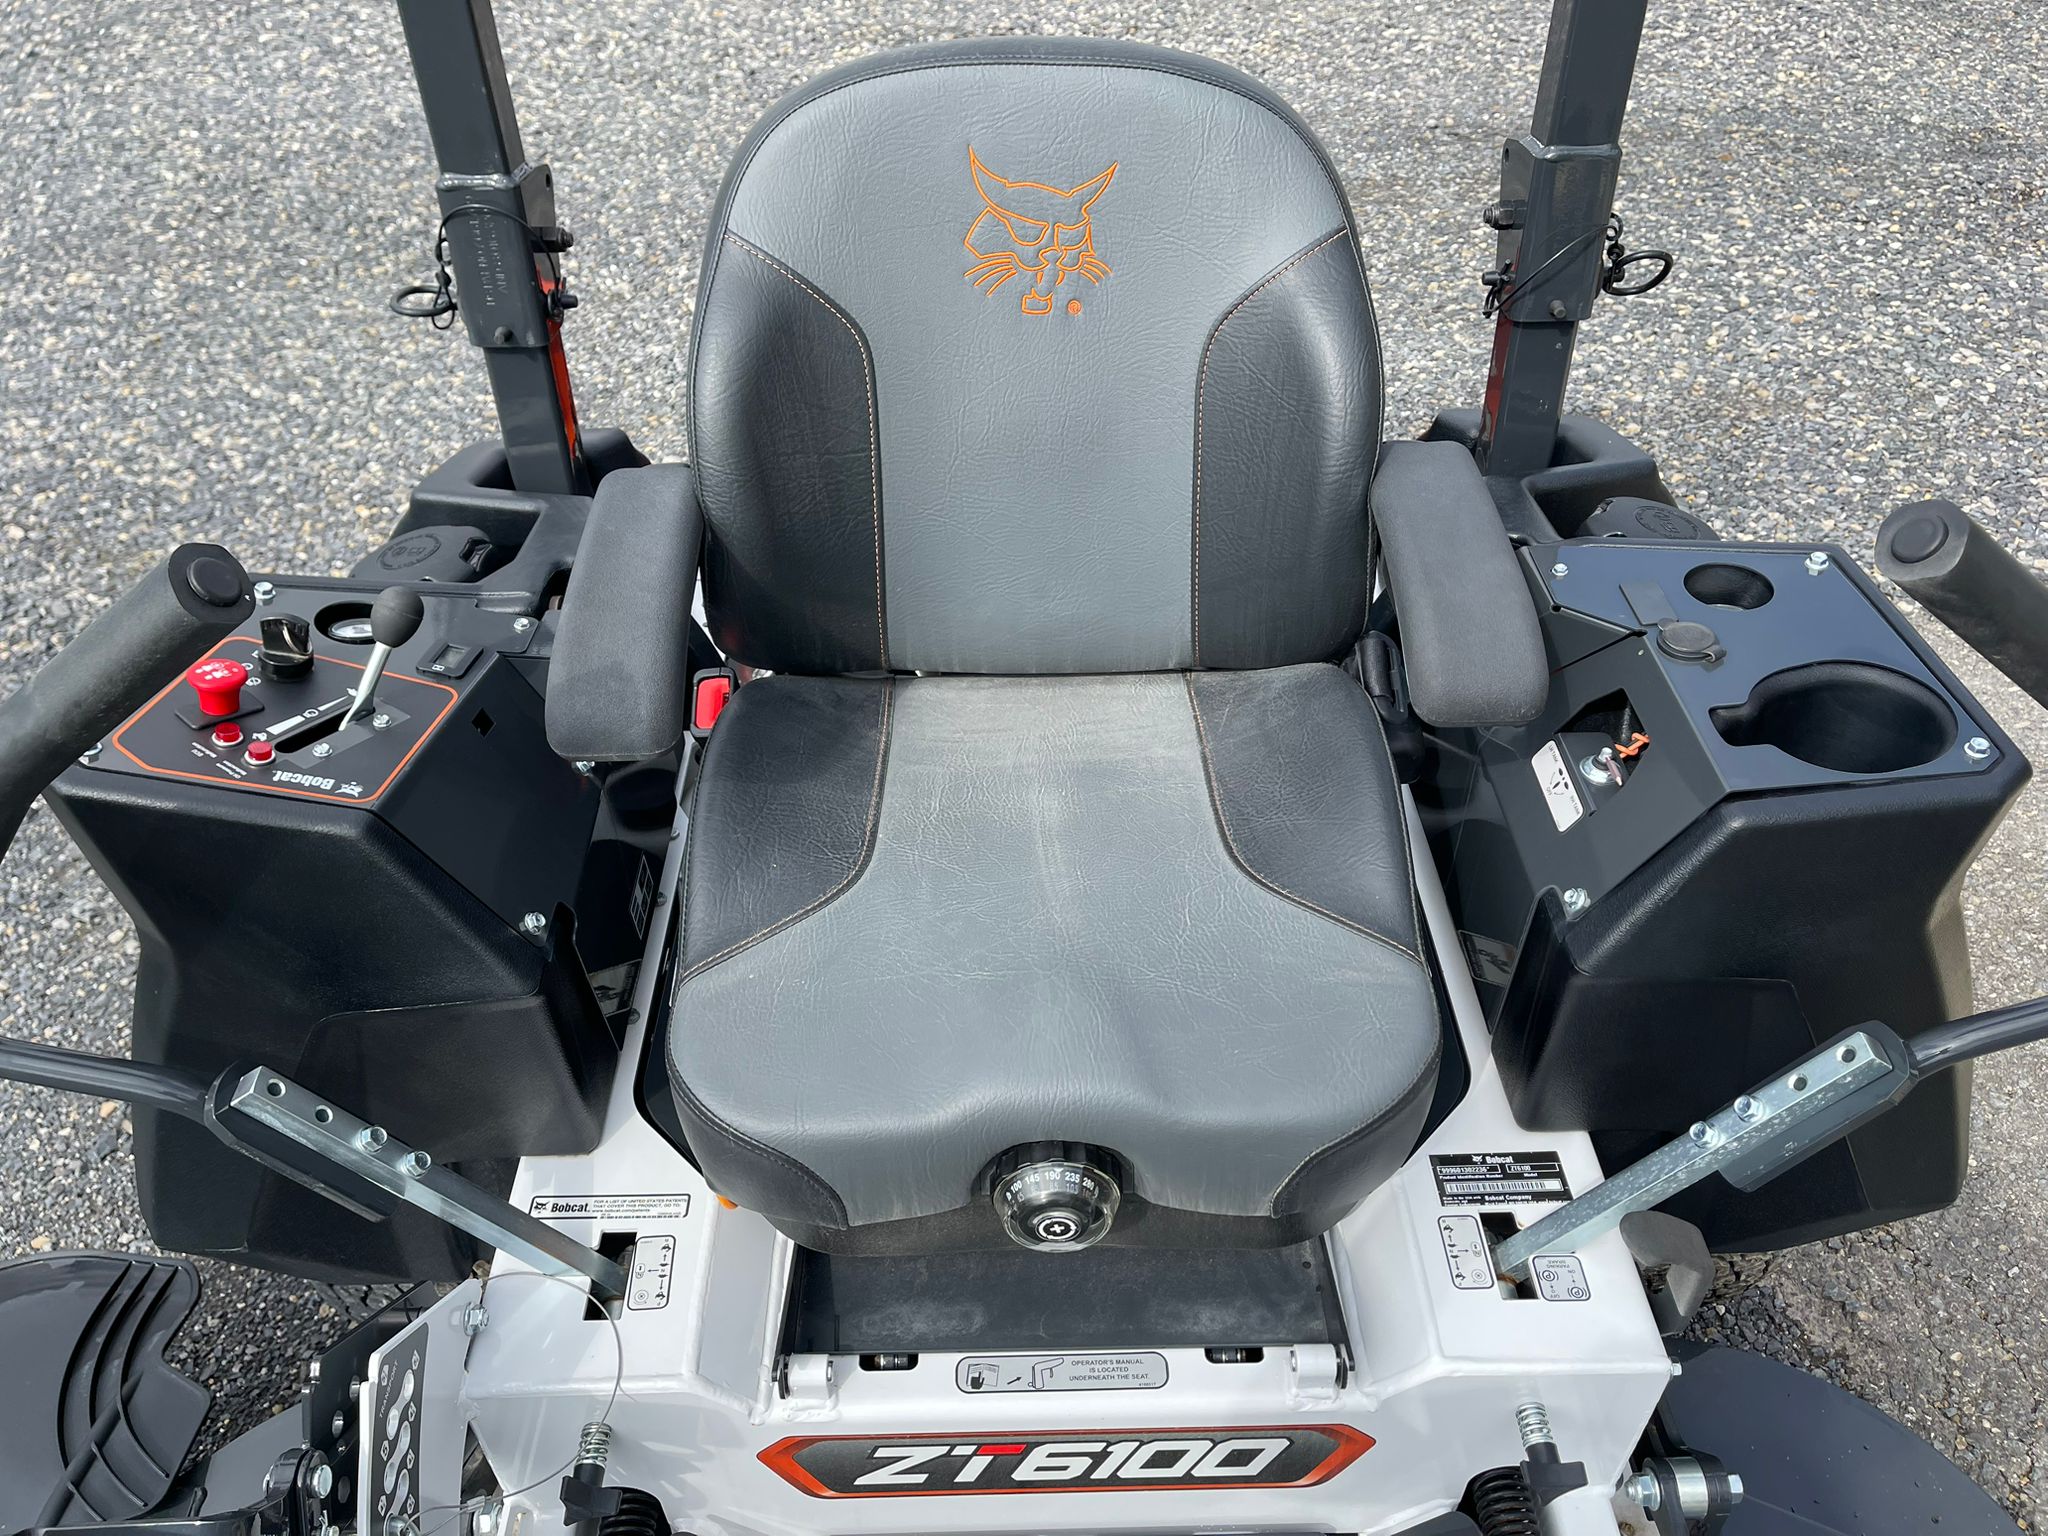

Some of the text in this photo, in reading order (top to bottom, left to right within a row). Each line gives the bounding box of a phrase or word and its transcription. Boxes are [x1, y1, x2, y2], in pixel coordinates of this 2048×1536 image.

[273, 770, 336, 790] Bobcat
[1485, 1155, 1514, 1165] Bobcat
[1010, 1181, 1022, 1194] 100
[1025, 1172, 1040, 1185] 145
[1044, 1171, 1061, 1180] 190
[1064, 1172, 1080, 1183] 235
[1505, 1194, 1532, 1202] Company
[550, 1202, 589, 1214] Bobcat
[1071, 1359, 1114, 1367] OPERATOR'S
[379, 1360, 398, 1418] TRANSPORT
[852, 1438, 1292, 1486] ZT6100
